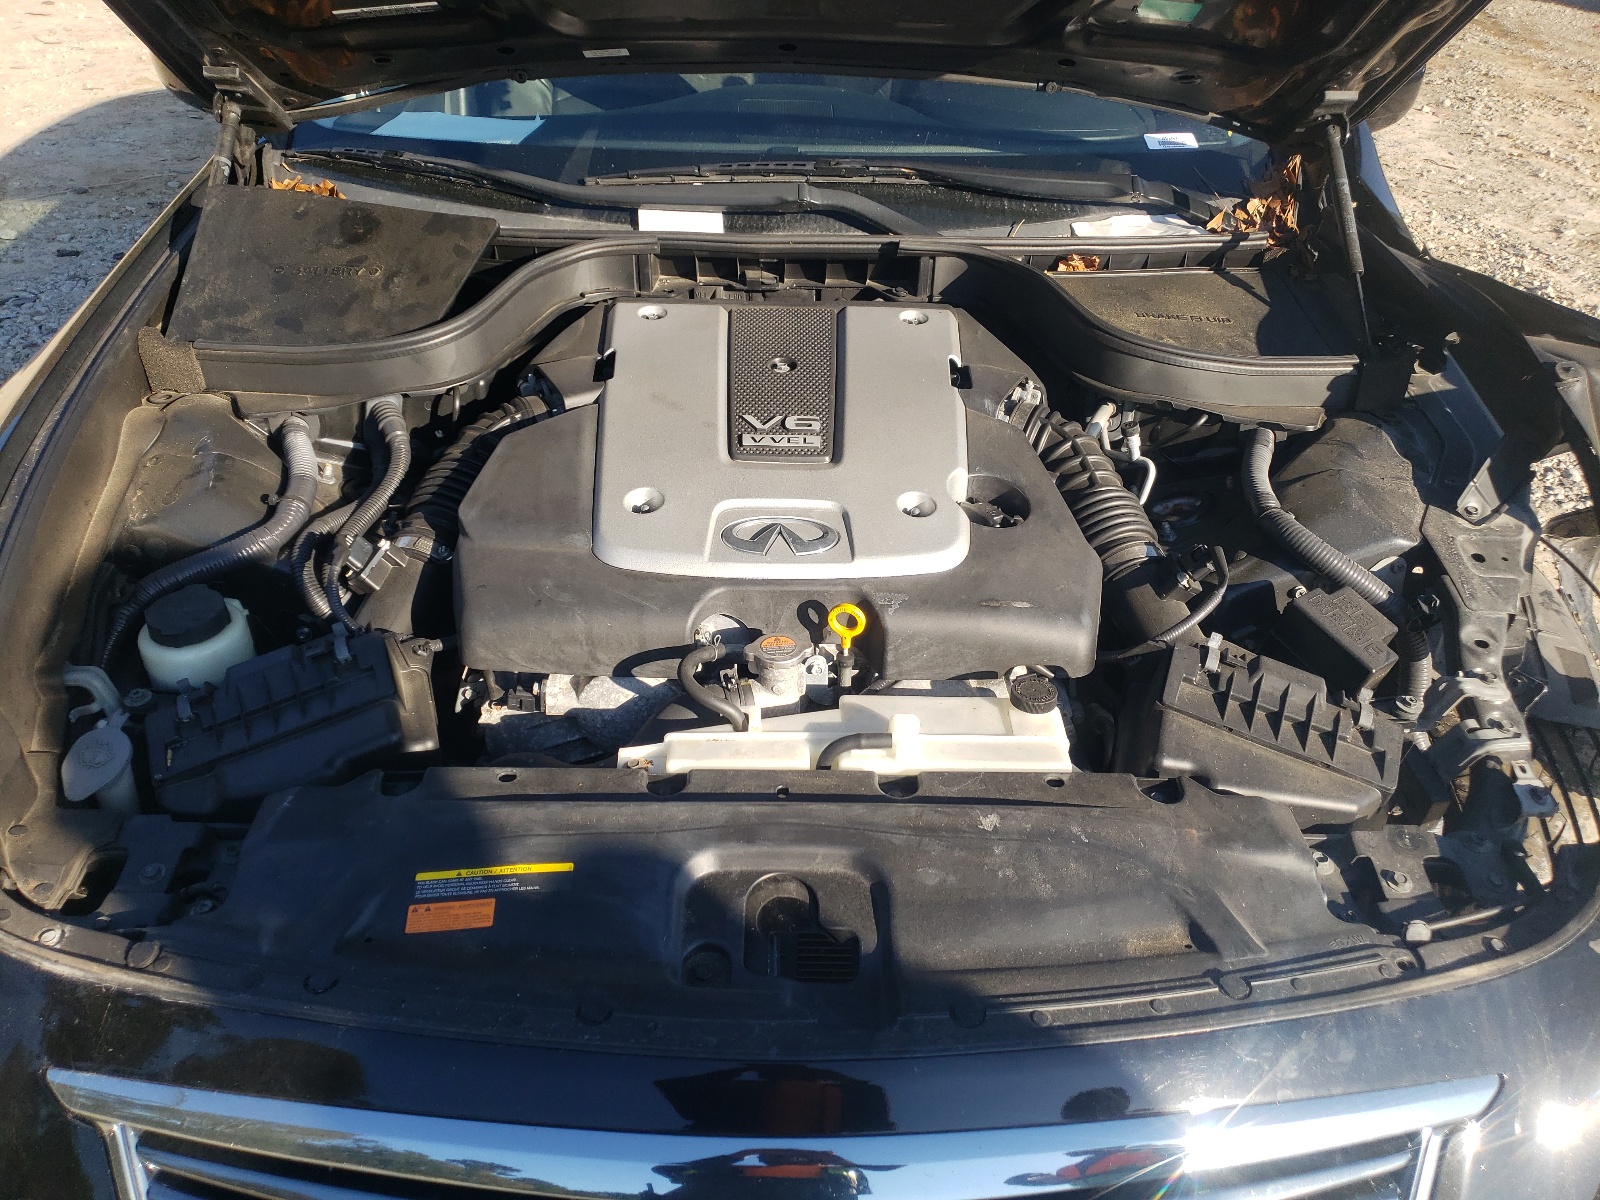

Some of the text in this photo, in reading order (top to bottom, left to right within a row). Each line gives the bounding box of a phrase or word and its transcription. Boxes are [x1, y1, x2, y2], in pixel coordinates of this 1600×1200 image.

[740, 414, 821, 431] V6
[750, 436, 815, 445] VVEL
[498, 866, 532, 874] ATTENTION
